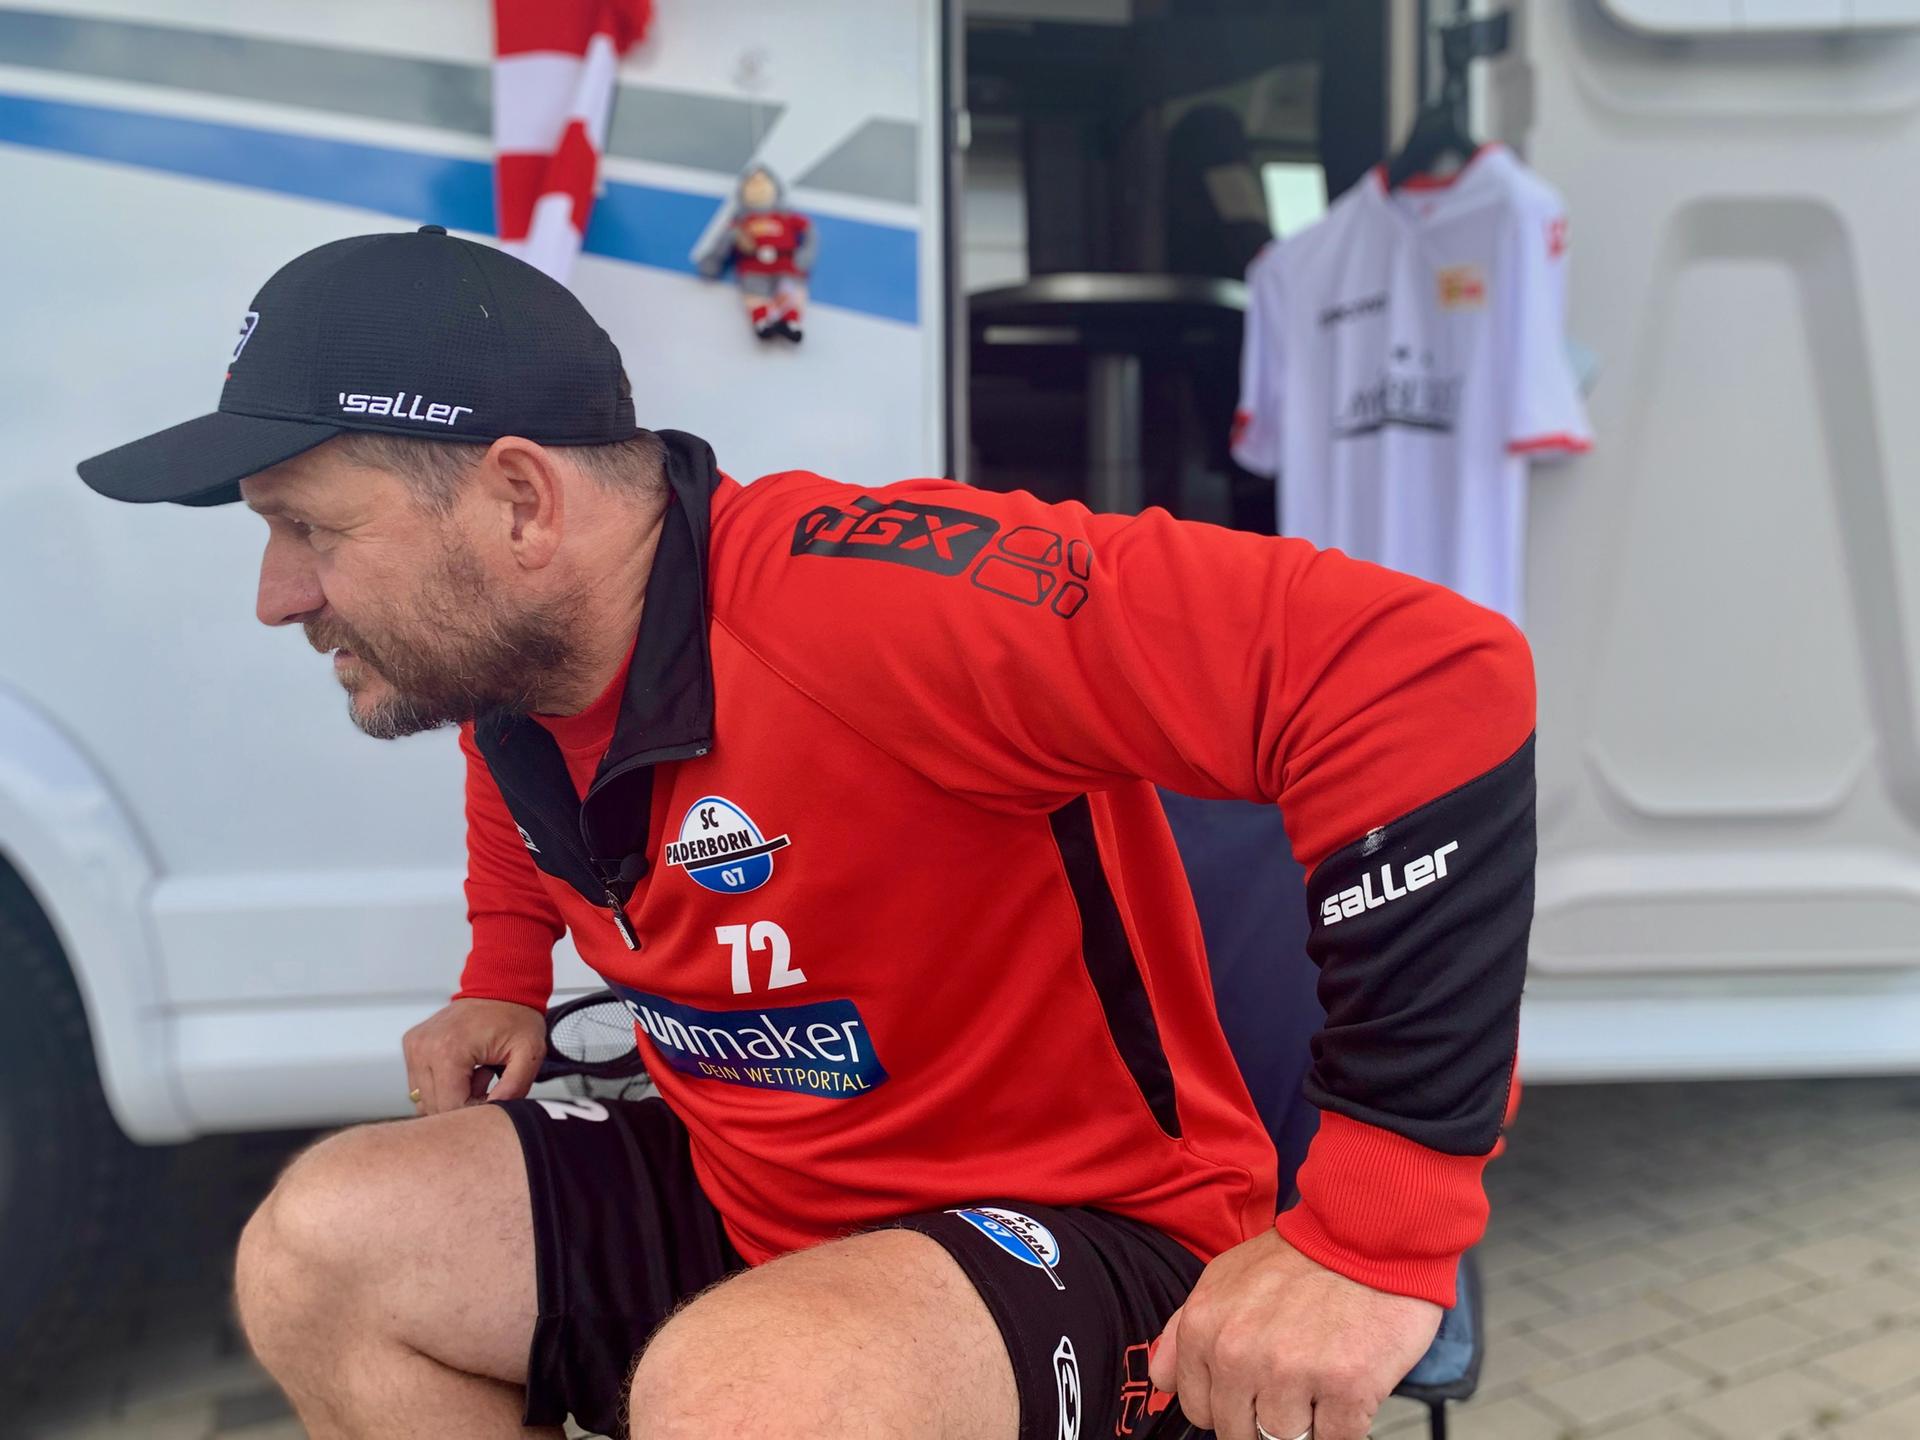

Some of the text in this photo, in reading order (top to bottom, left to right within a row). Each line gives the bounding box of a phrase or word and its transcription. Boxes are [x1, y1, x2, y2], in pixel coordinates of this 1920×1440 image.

[700, 806, 719, 830] SC
[666, 829, 753, 864] PADERBORN
[721, 866, 746, 887] 07
[715, 920, 807, 994] 72
[698, 1061, 871, 1092] DEIN WETTPORTAL
[983, 1220, 1013, 1238] 07
[1014, 1215, 1040, 1231] SC
